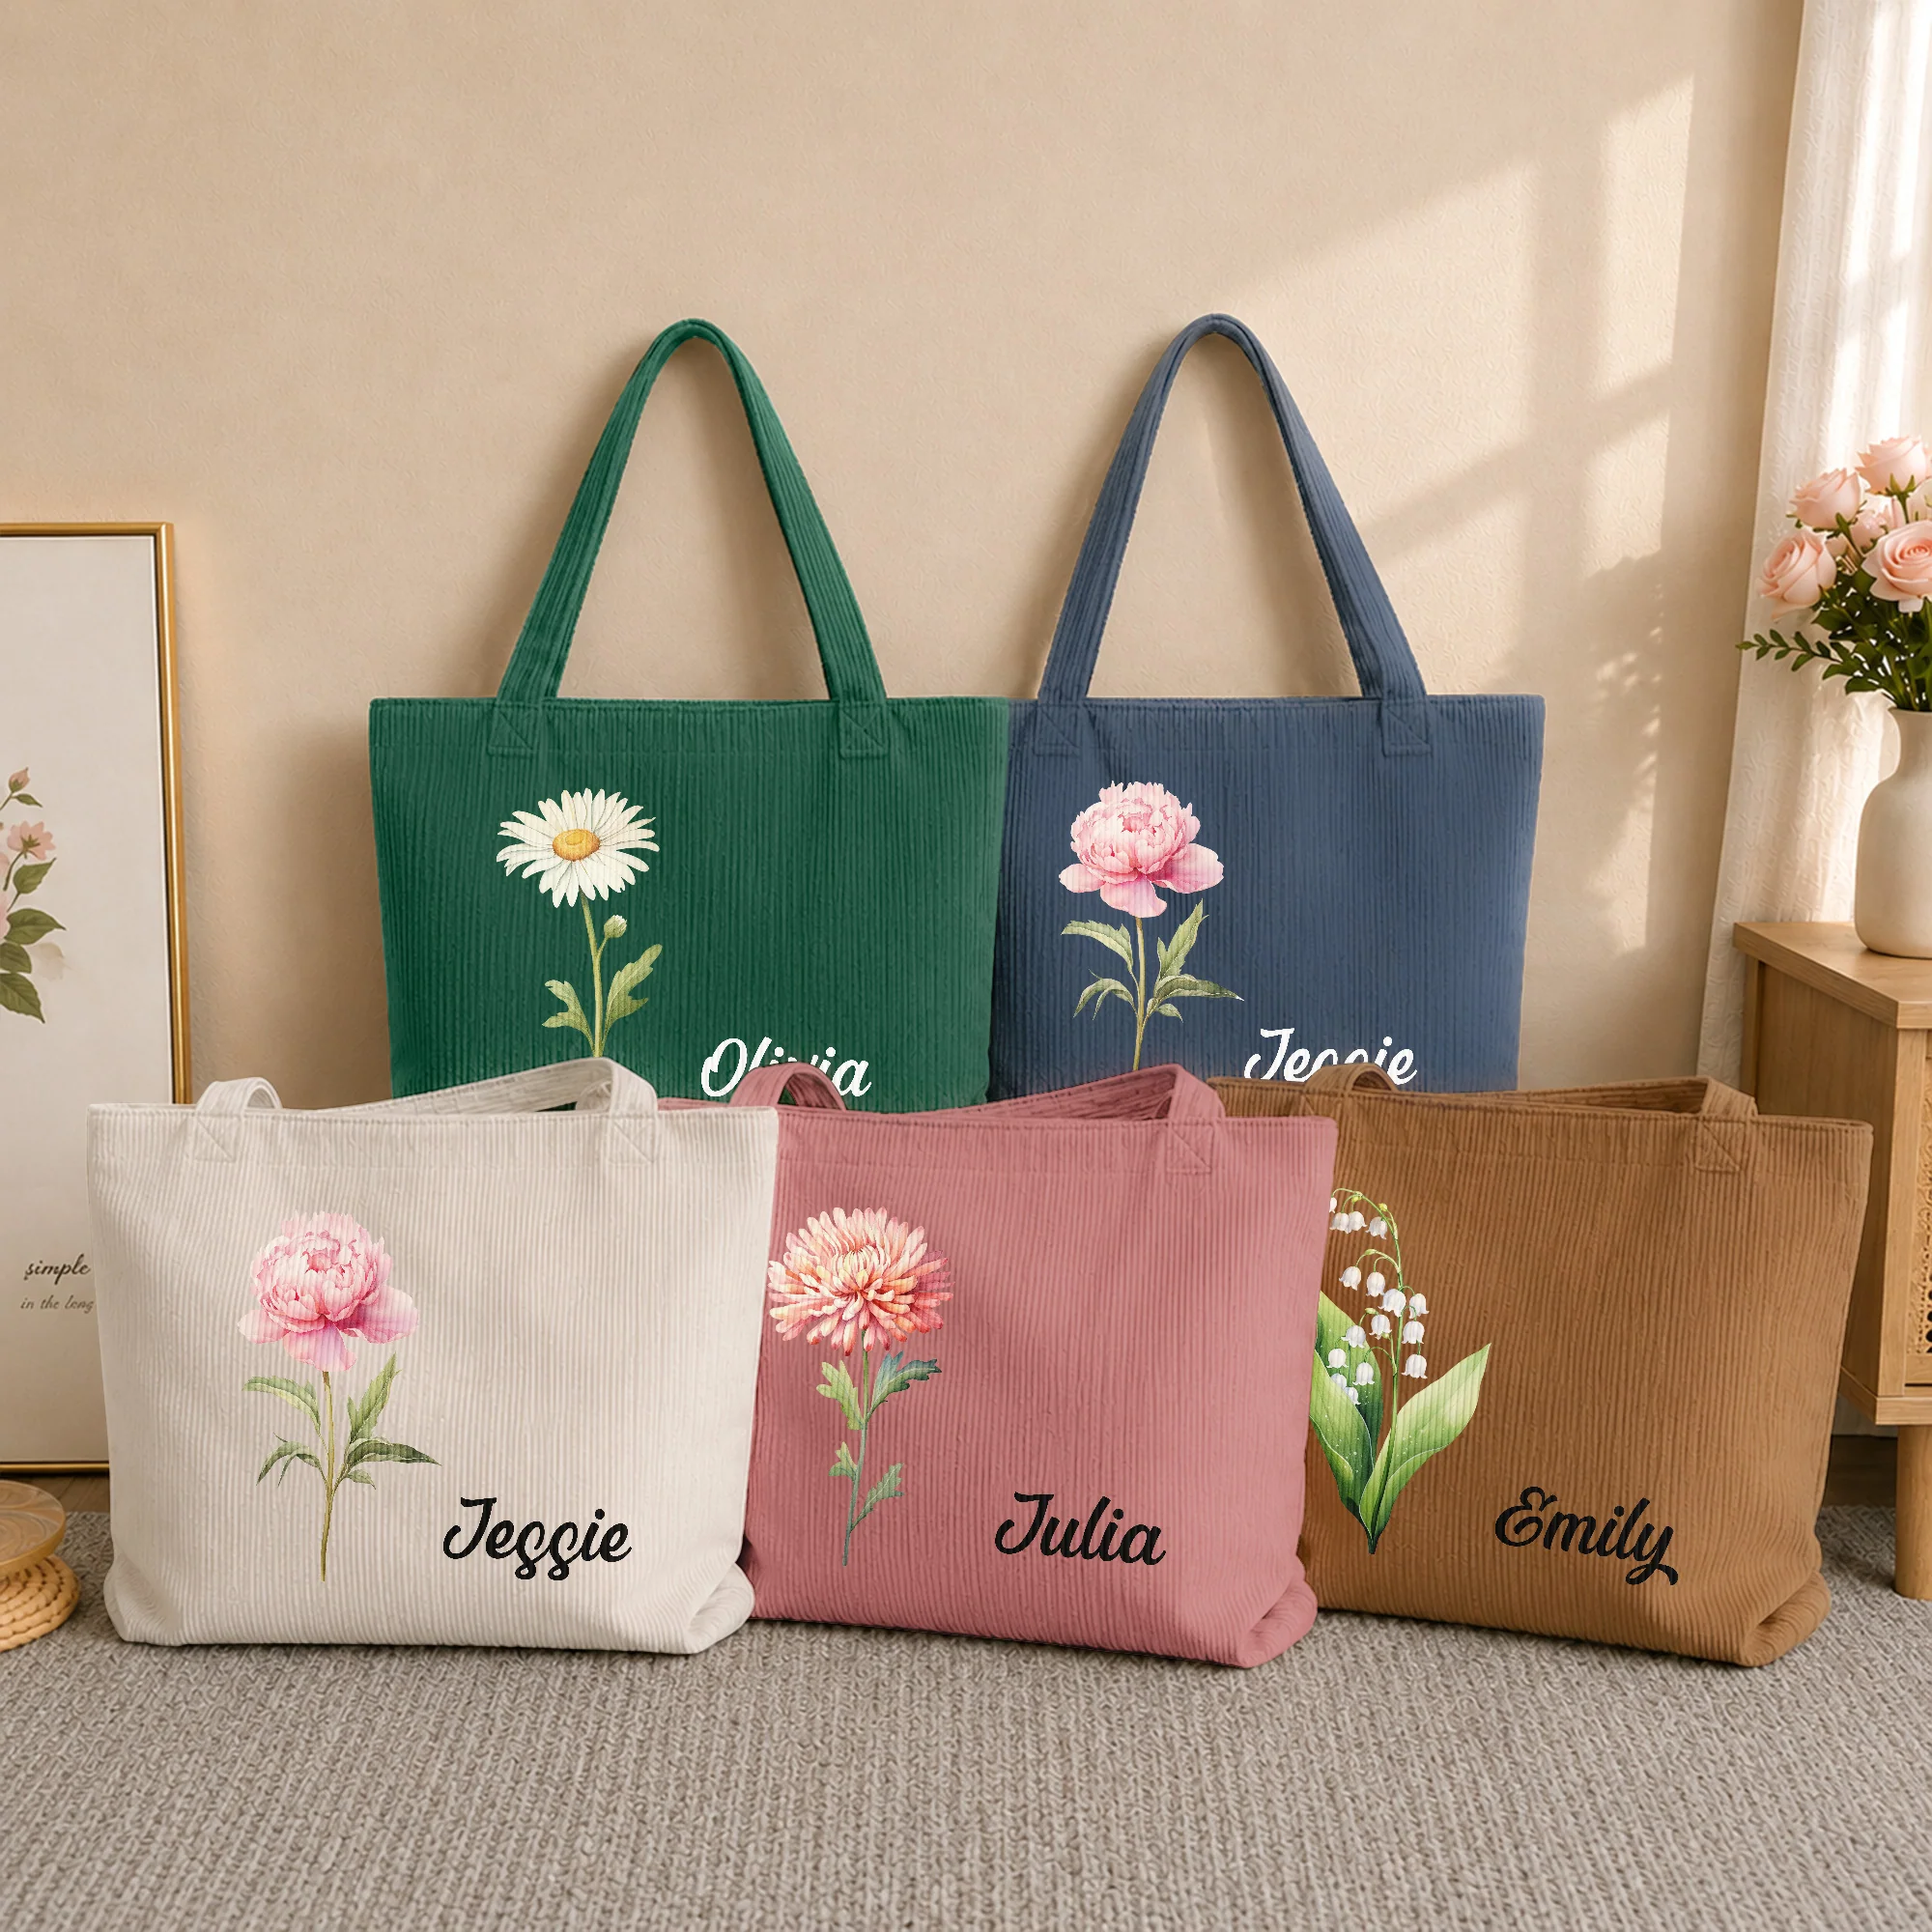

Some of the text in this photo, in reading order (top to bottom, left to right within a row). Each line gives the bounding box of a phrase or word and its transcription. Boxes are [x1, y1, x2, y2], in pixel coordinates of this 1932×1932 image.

[1244, 1028, 1417, 1085] Jeie
[24, 1253, 92, 1285] simple
[20, 1297, 34, 1310] in
[40, 1294, 59, 1310] the
[443, 1497, 632, 1580] Jessie
[995, 1492, 1166, 1565] Julia
[1495, 1487, 1678, 1585] Emily
